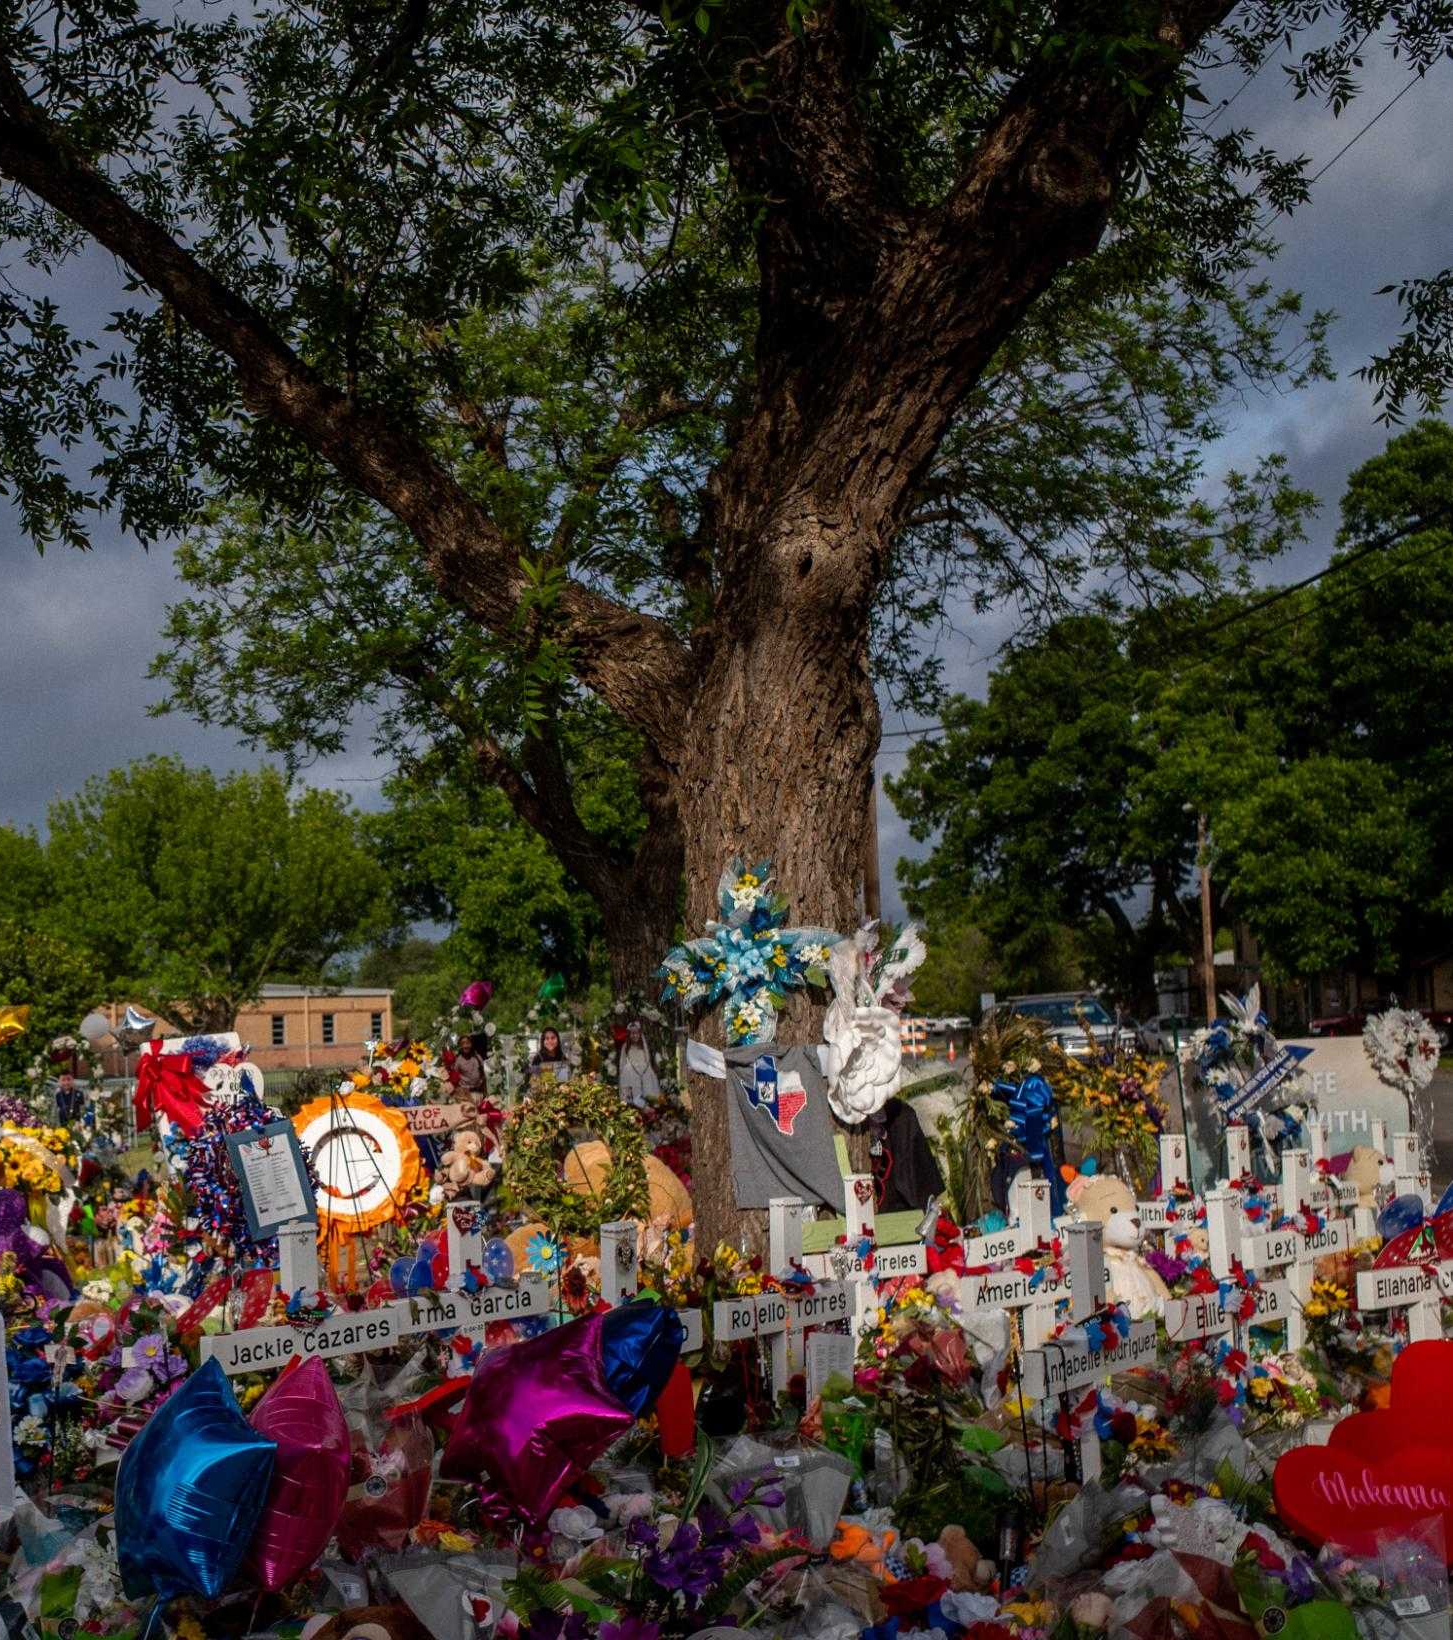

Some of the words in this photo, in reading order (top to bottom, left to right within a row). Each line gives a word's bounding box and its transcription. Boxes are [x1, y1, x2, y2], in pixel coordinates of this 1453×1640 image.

[406, 1118, 450, 1131] TULLA
[422, 1107, 441, 1119] OF
[982, 1239, 1015, 1260] Jose
[1266, 1236, 1297, 1260] Lexi
[1304, 1229, 1338, 1251] Rubio
[874, 1254, 917, 1272] ireles
[471, 1289, 532, 1317] Garcia
[977, 1279, 1036, 1306] Amerie
[731, 1302, 785, 1330] Roelio
[795, 1291, 847, 1319] Torres
[1195, 1301, 1226, 1330] Ellie
[1256, 1291, 1278, 1315] cia
[229, 1338, 294, 1366] Jackie
[304, 1319, 391, 1353] Cazares
[1043, 1349, 1102, 1387] nnabelle
[1310, 1467, 1450, 1512] Makenna
